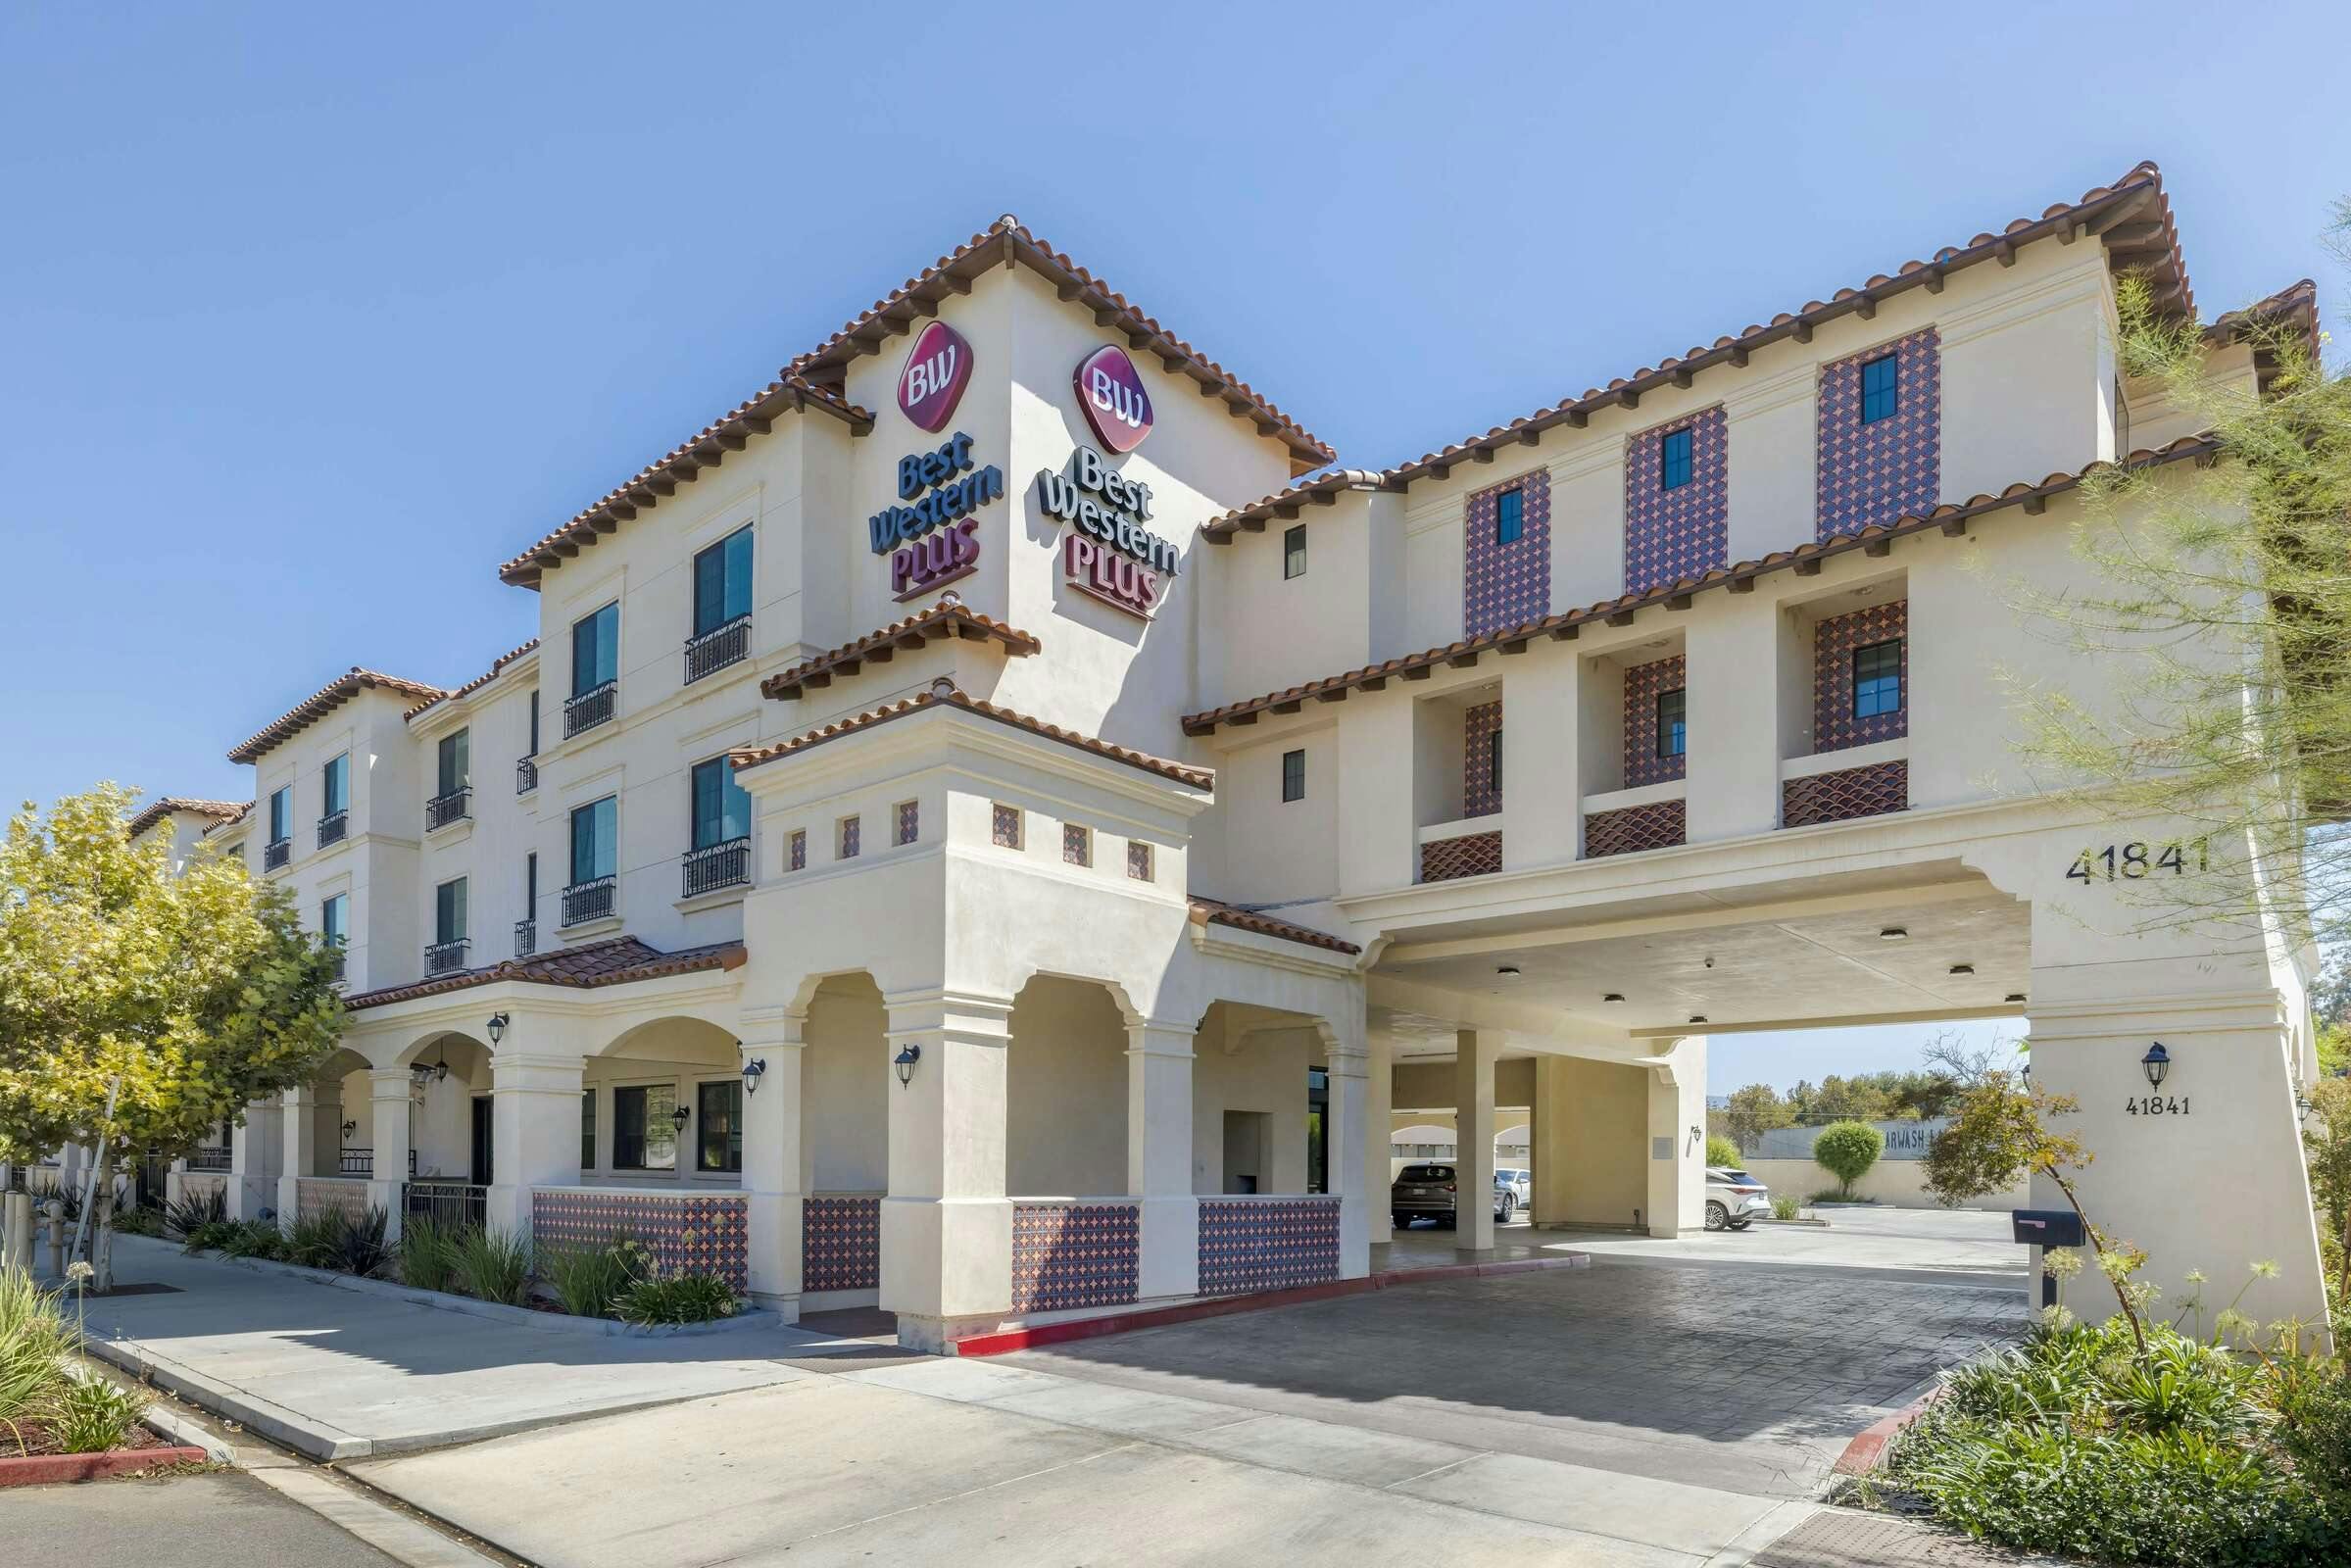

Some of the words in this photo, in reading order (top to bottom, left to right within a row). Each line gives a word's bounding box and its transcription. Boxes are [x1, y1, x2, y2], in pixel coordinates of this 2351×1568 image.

[907, 344, 956, 408] BW
[1092, 367, 1144, 428] BW
[899, 431, 974, 501] Best
[1077, 445, 1154, 521] Best
[869, 465, 1004, 556] Western
[1037, 468, 1182, 576] Western
[892, 516, 980, 593] PLUS
[1066, 534, 1159, 610] PLUS
[2066, 836, 2211, 885] 41841
[1885, 1129, 1924, 1150] ARWASH
[2126, 1097, 2190, 1116] 41841
